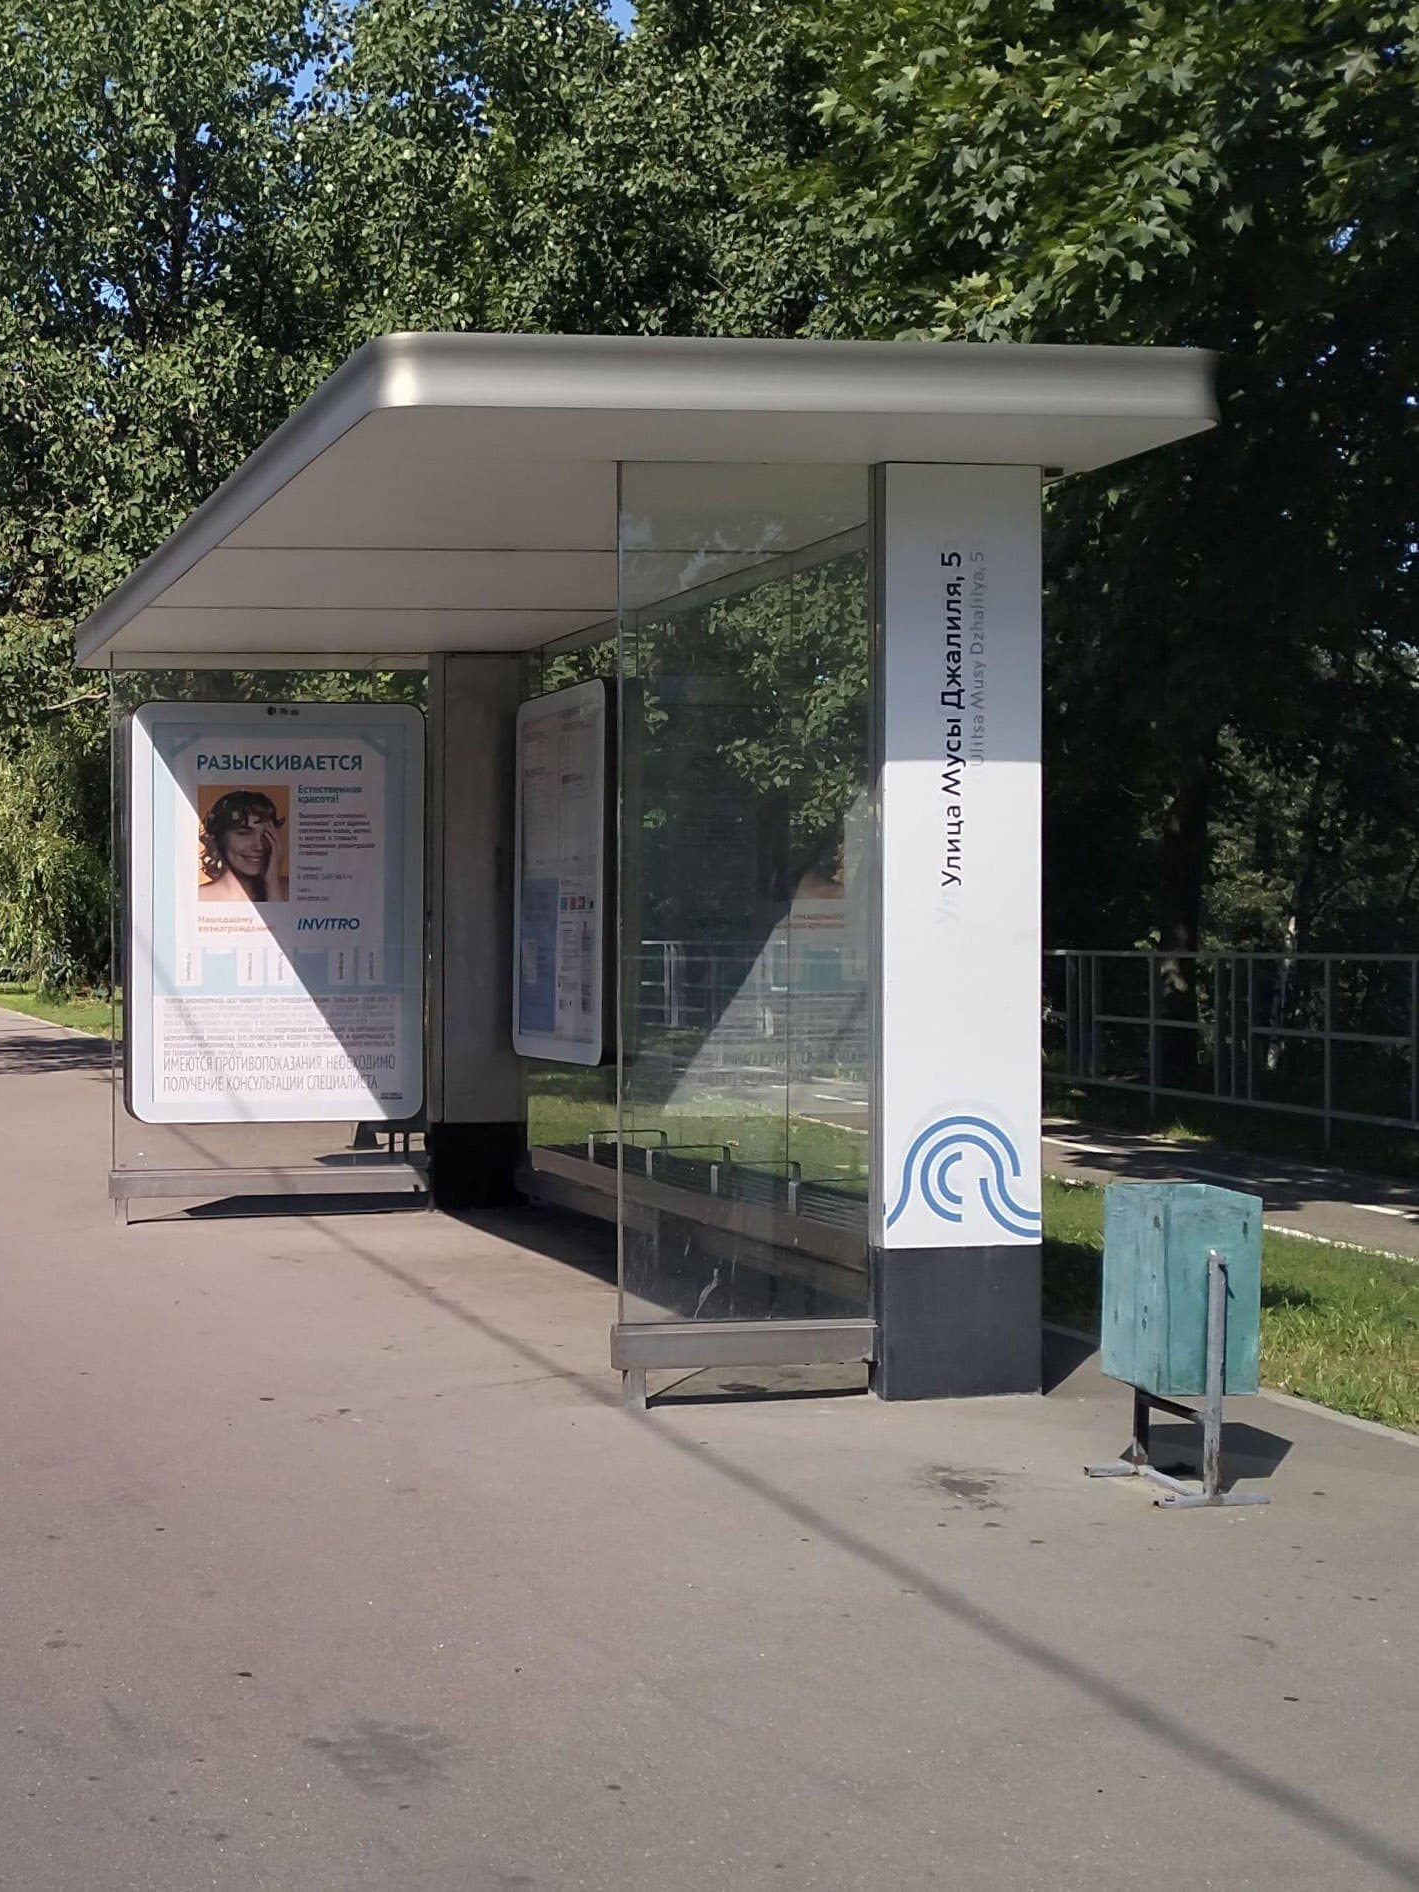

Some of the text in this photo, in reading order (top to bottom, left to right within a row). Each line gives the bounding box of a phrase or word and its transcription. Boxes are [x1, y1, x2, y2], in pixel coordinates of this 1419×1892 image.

[970, 552, 984, 562] 5
[970, 661, 987, 709] Musy
[941, 552, 966, 887] Улица Мусы Джалиля, 5
[970, 715, 985, 767] Ulitsa
[196, 754, 363, 771] РАЗЫСКИВАЕТСЯ
[297, 918, 360, 930] INVITRO
[164, 1056, 212, 1072] ИМЕЮТСЯ
[326, 1054, 396, 1071] НЕОБХОДИМО
[164, 1074, 378, 1092] ПОЛУЧЕНИЕ КОНСУЛЬТАЦИИ СПЕЦИАЛИСТА
